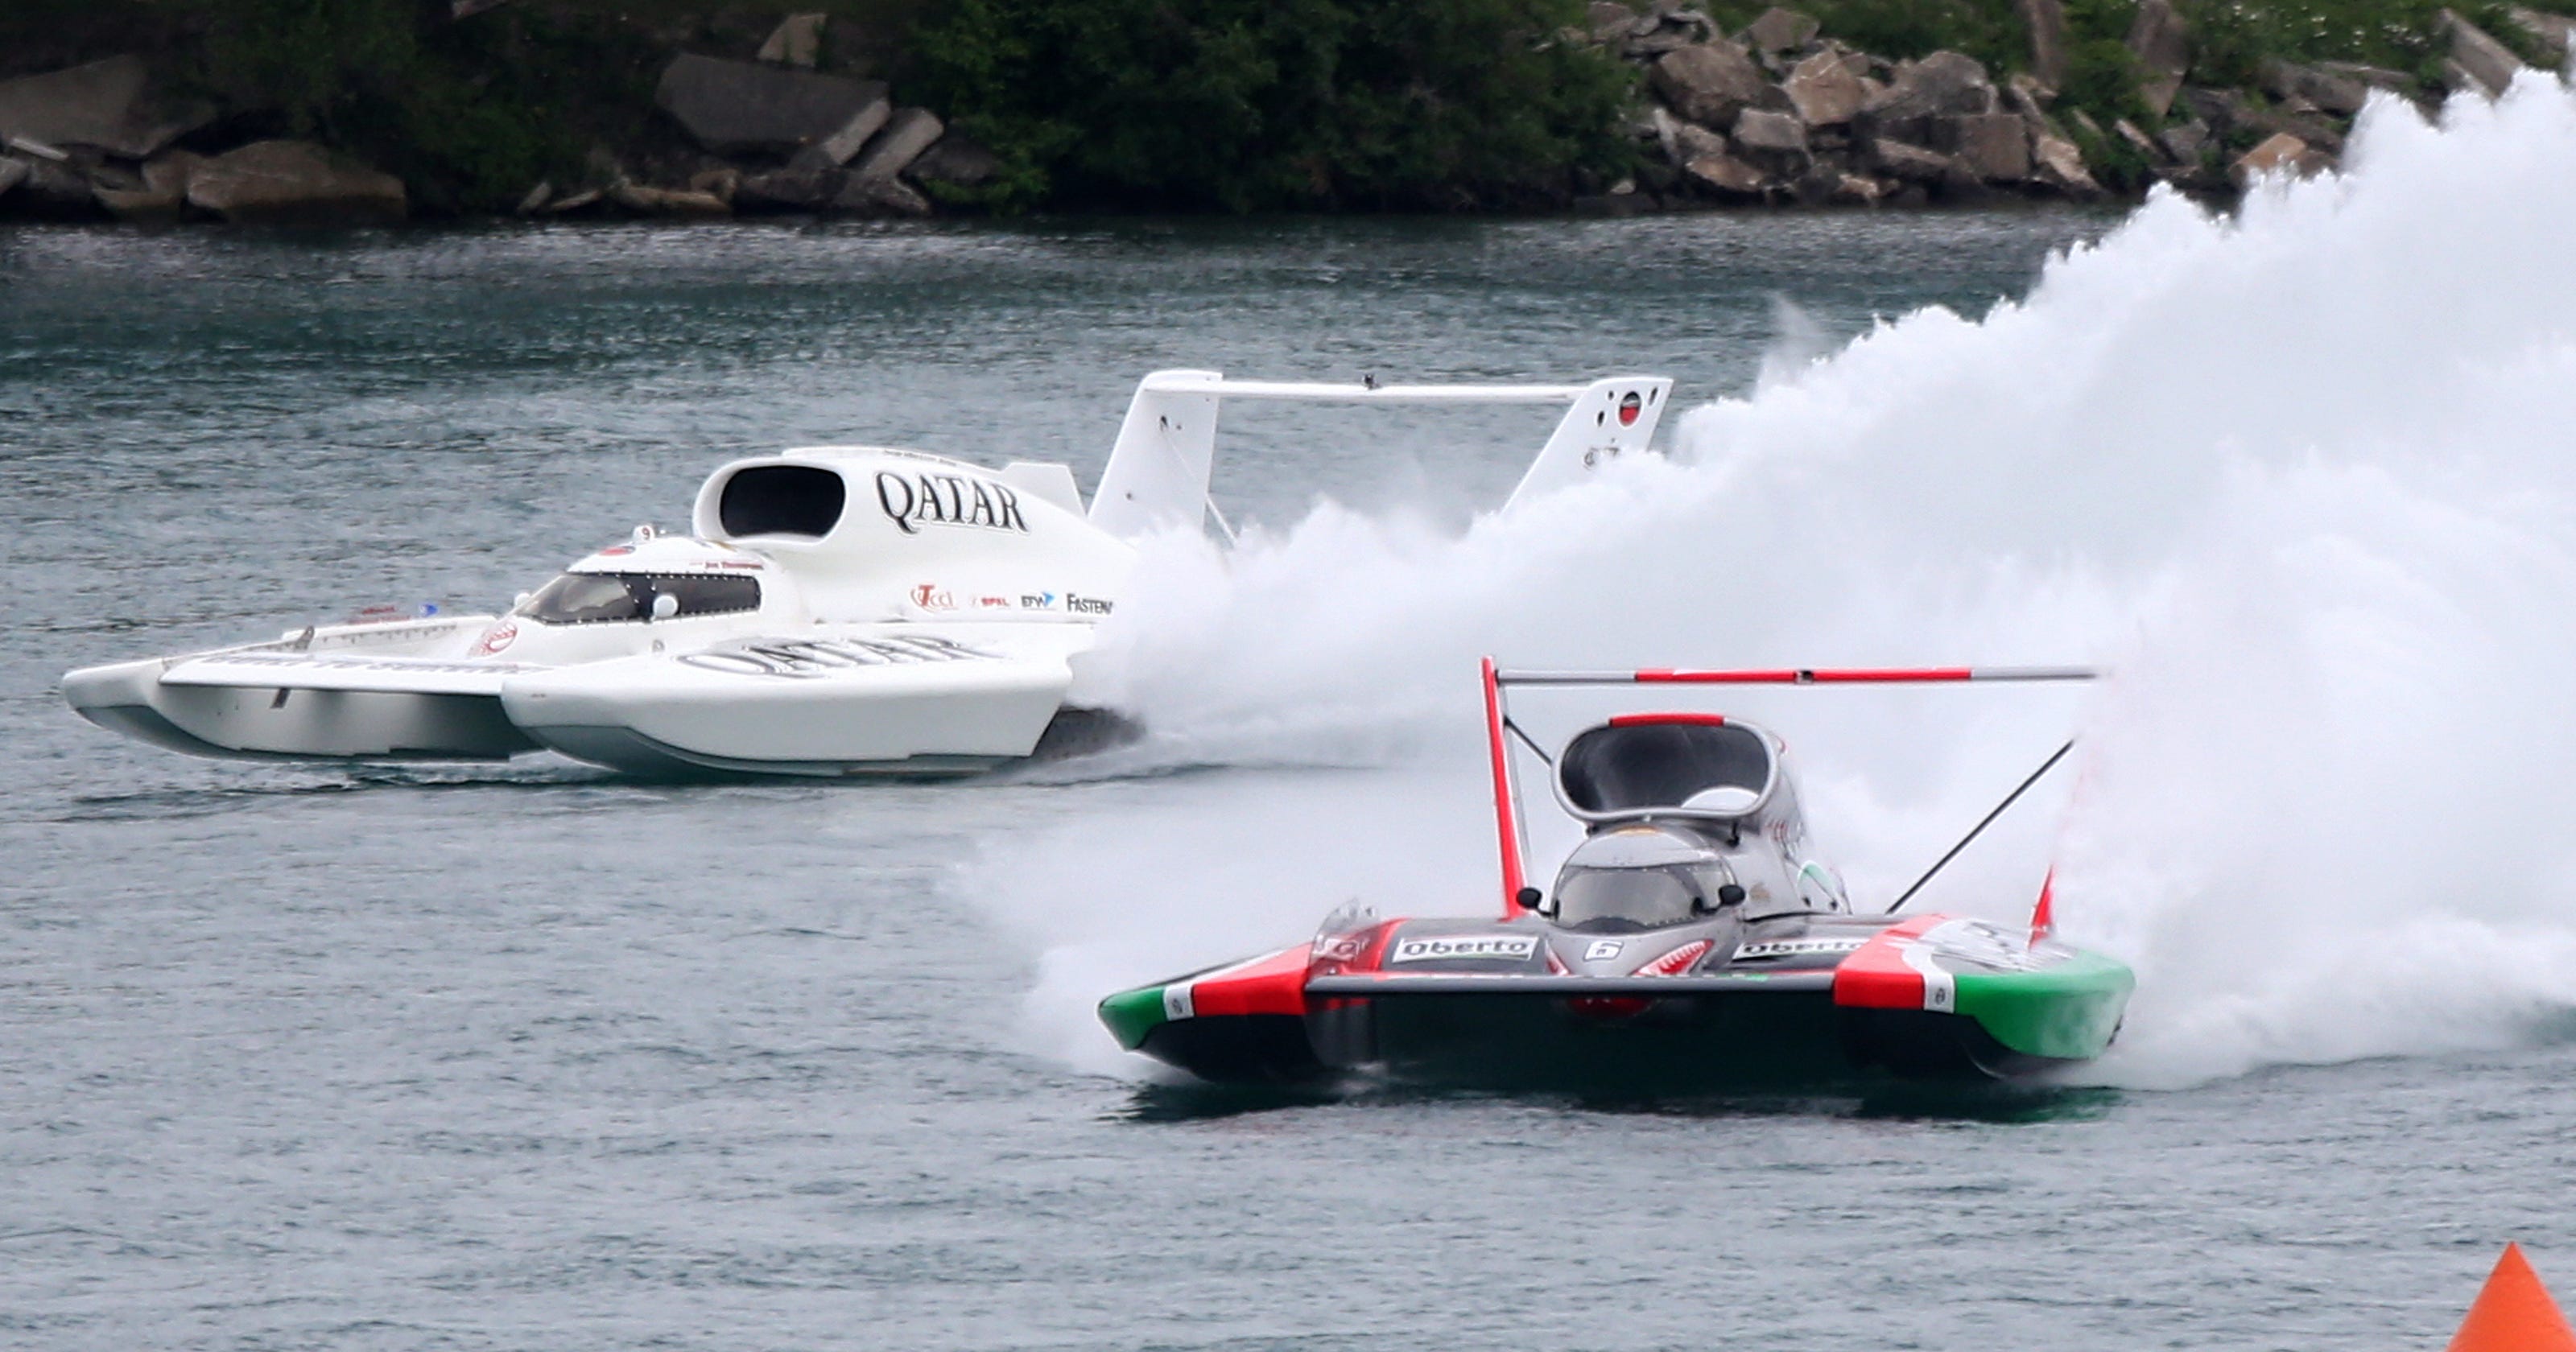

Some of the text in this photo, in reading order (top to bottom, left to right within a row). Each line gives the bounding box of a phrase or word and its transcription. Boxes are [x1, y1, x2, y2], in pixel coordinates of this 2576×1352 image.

[877, 472, 1029, 534] QATAR
[1067, 593, 1113, 614] FASTEN
[1404, 942, 1529, 956] Oberto
[1583, 941, 1624, 961] 6
